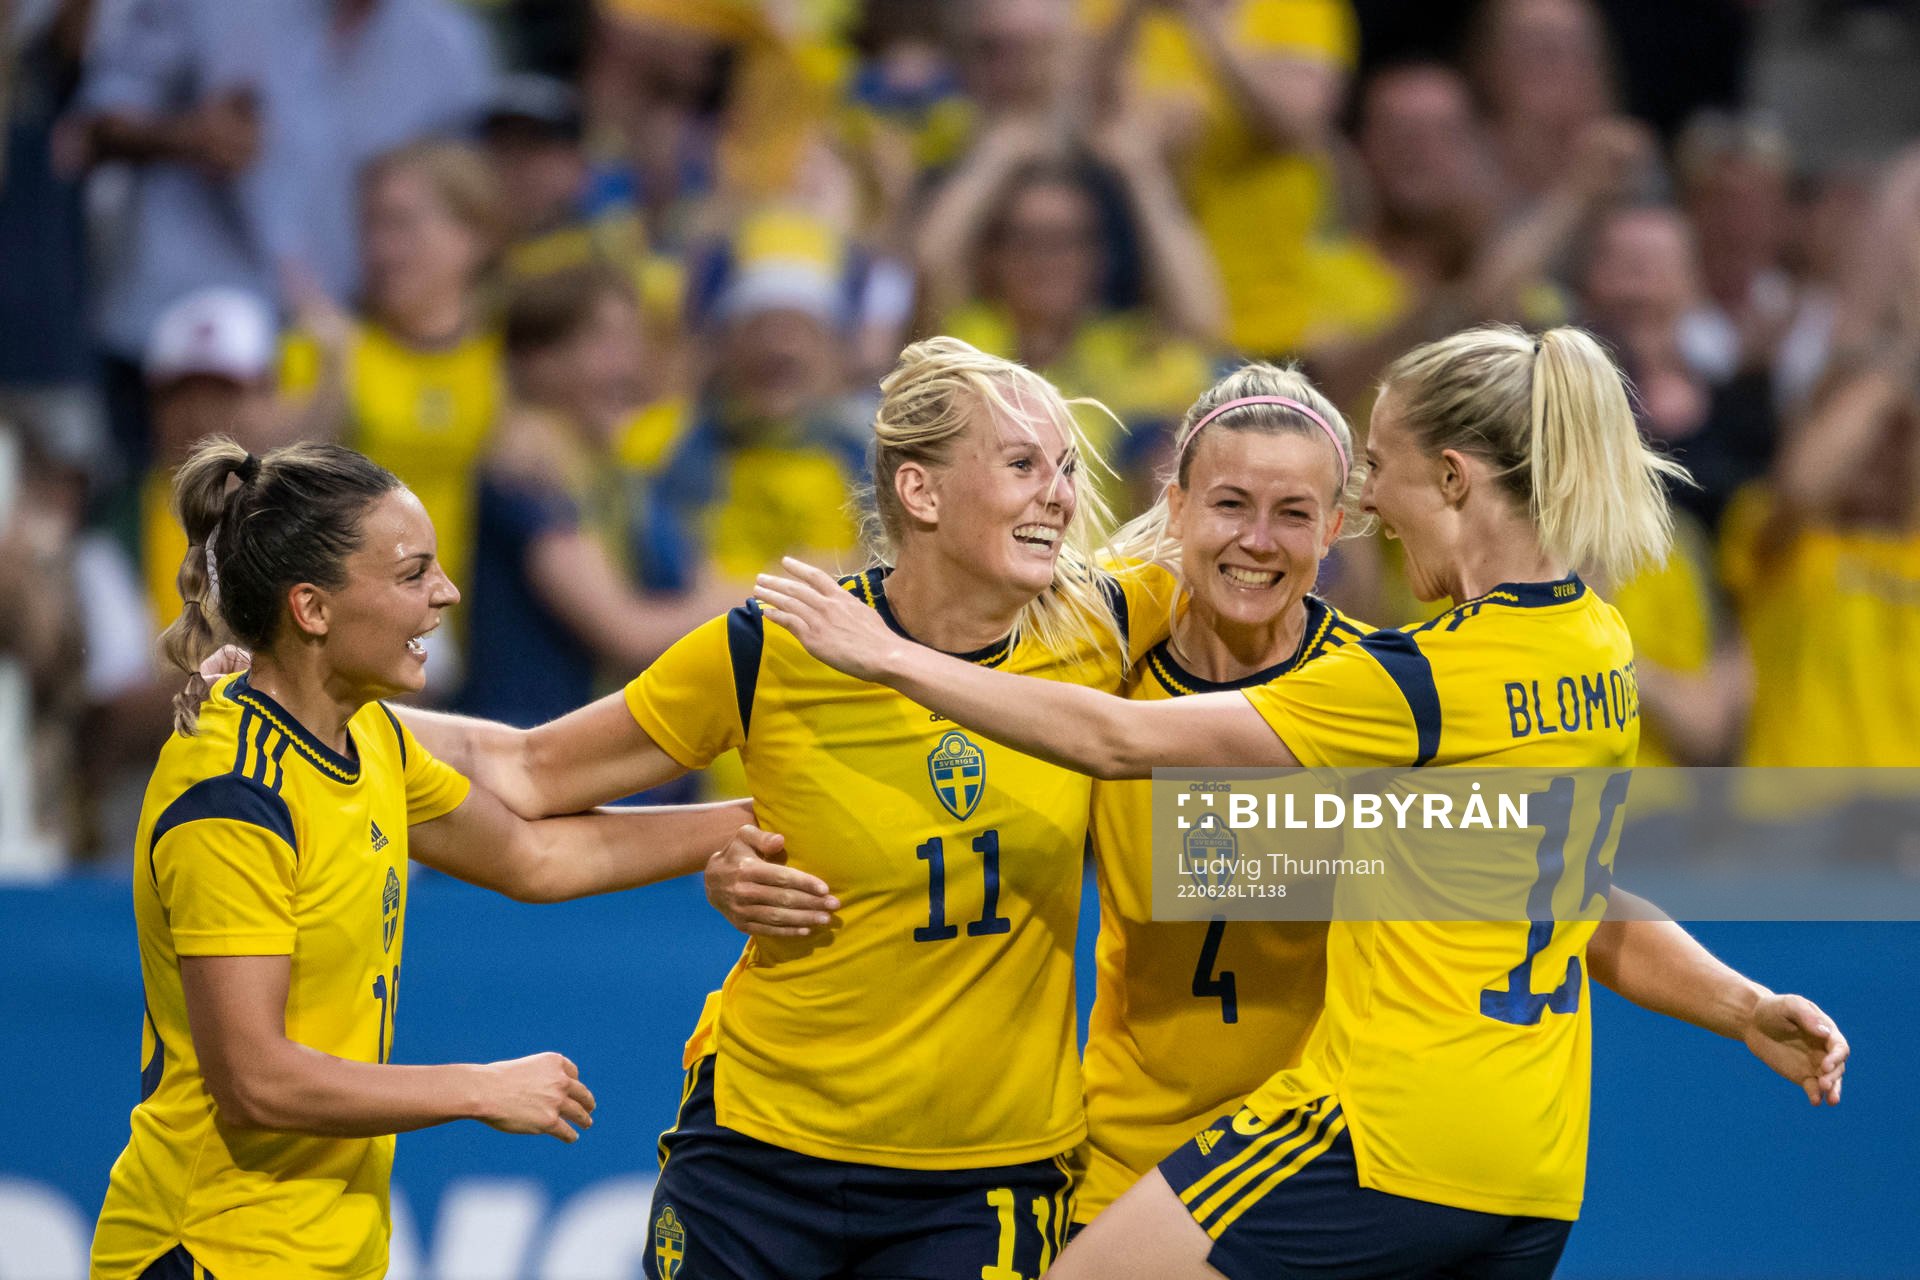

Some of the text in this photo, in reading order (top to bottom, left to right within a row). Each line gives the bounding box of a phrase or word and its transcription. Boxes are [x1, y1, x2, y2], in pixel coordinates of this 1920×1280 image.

[938, 758, 975, 767] SVERIGE
[1189, 781, 1231, 792] adidas
[914, 830, 1010, 942] 11
[1192, 914, 1238, 1024] 4
